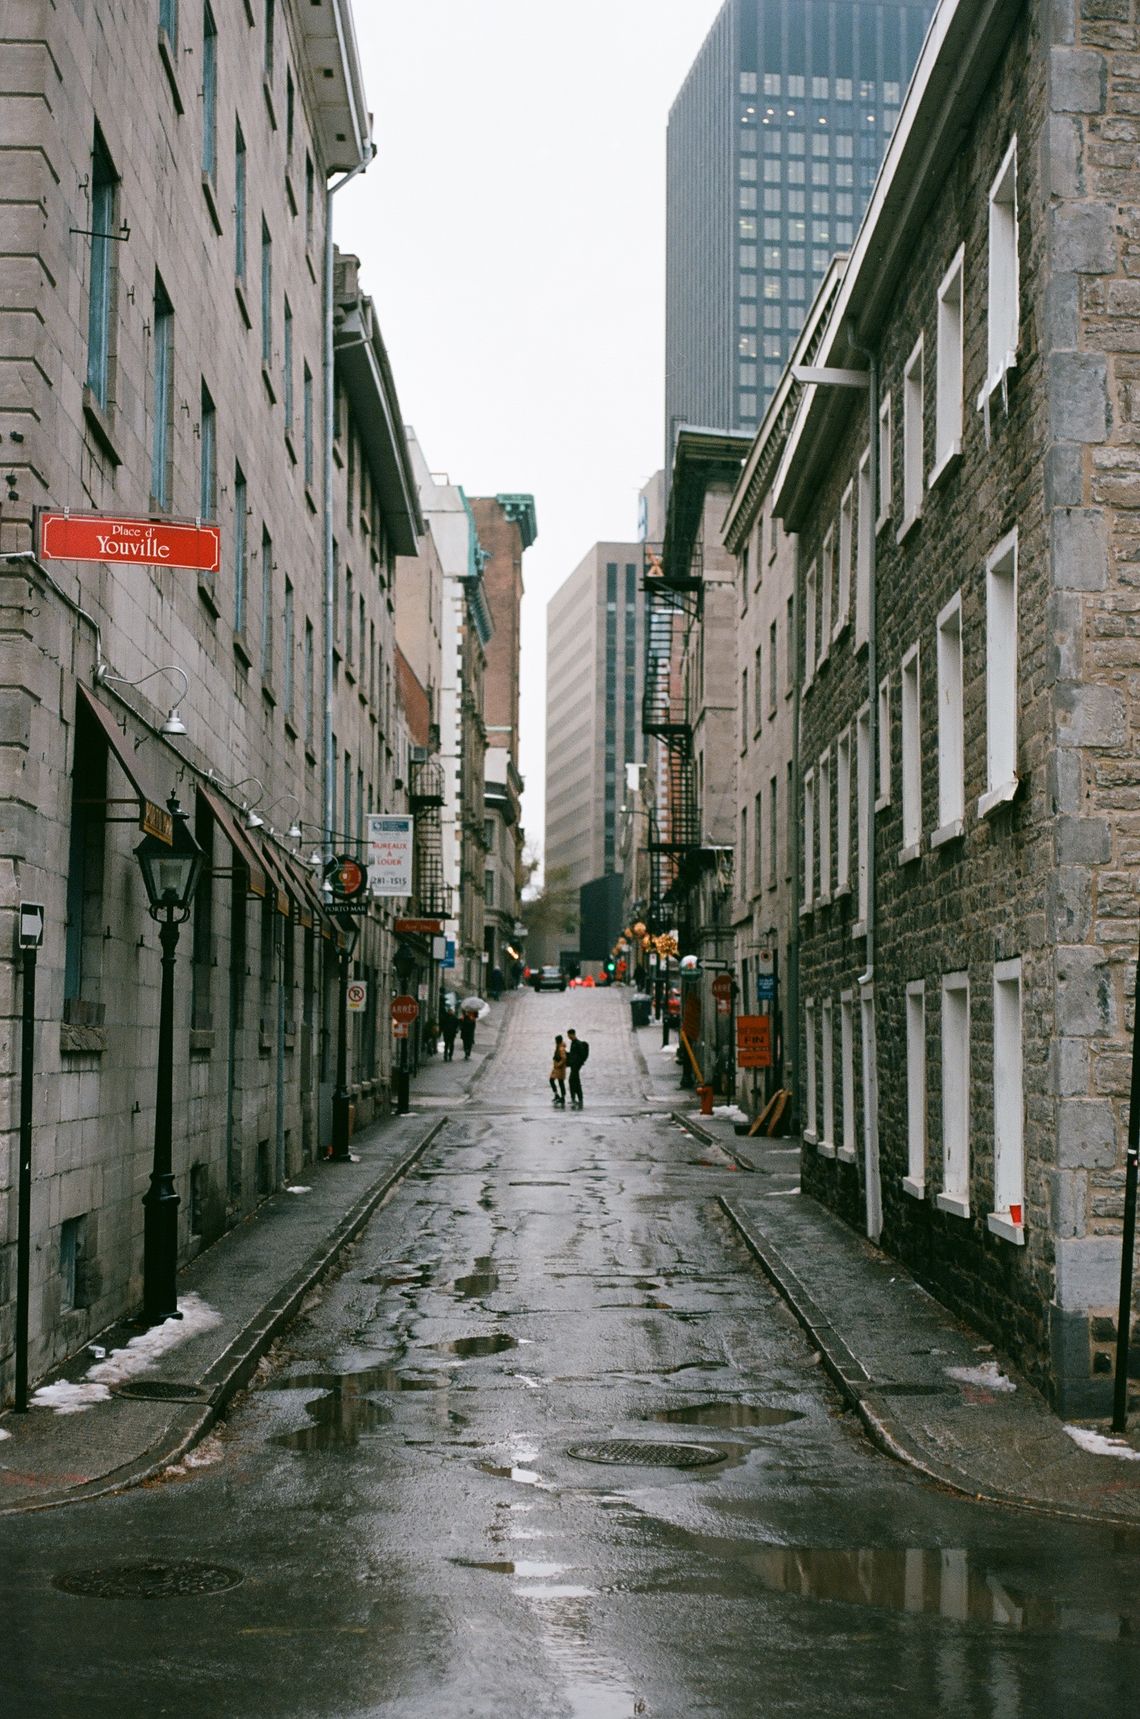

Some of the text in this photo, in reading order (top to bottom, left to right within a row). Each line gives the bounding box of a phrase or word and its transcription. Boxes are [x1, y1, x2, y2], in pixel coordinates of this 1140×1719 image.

[112, 525, 141, 537] Place
[96, 535, 170, 558] Youville
[392, 1003, 416, 1013] ARRÊT
